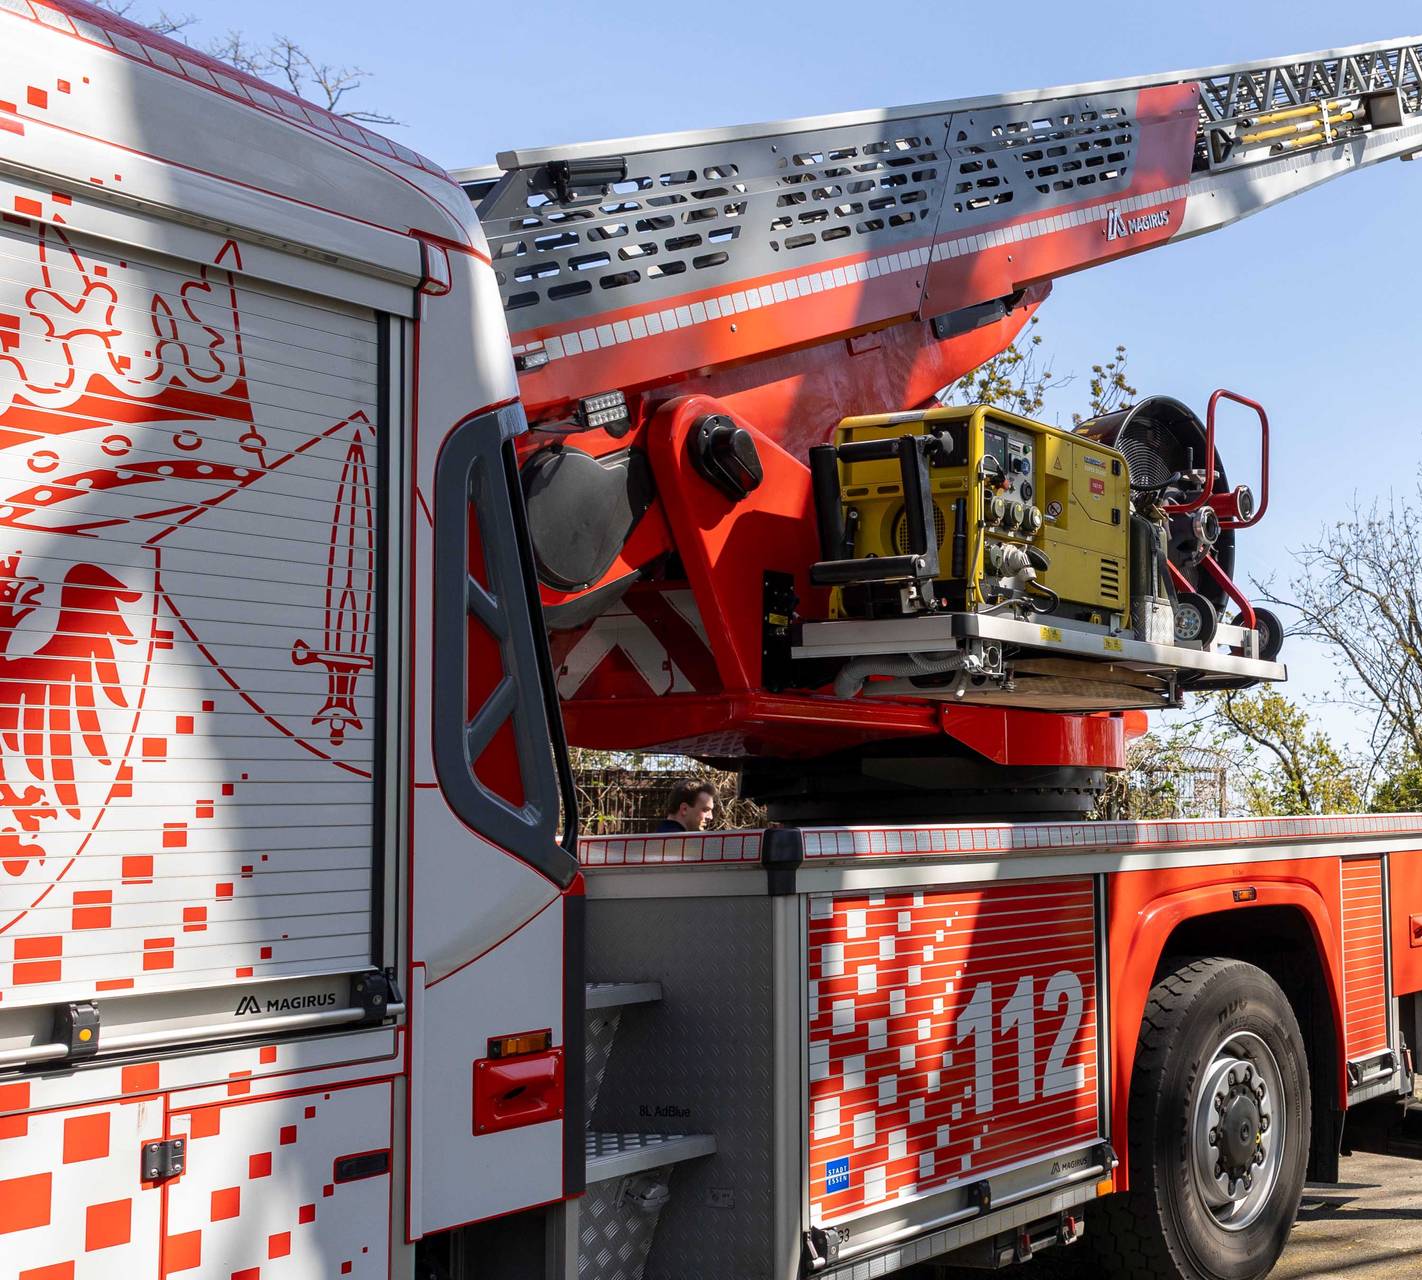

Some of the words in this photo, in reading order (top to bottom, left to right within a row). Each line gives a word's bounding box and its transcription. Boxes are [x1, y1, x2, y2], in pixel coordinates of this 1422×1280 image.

[1127, 210, 1169, 235] MAGIRUS
[266, 993, 336, 1013] MAGIRUS
[957, 970, 1085, 1115] 112
[827, 1165, 848, 1177] STADT
[1061, 1156, 1088, 1171] MAGIRUS
[827, 1175, 848, 1186] ESSEN
